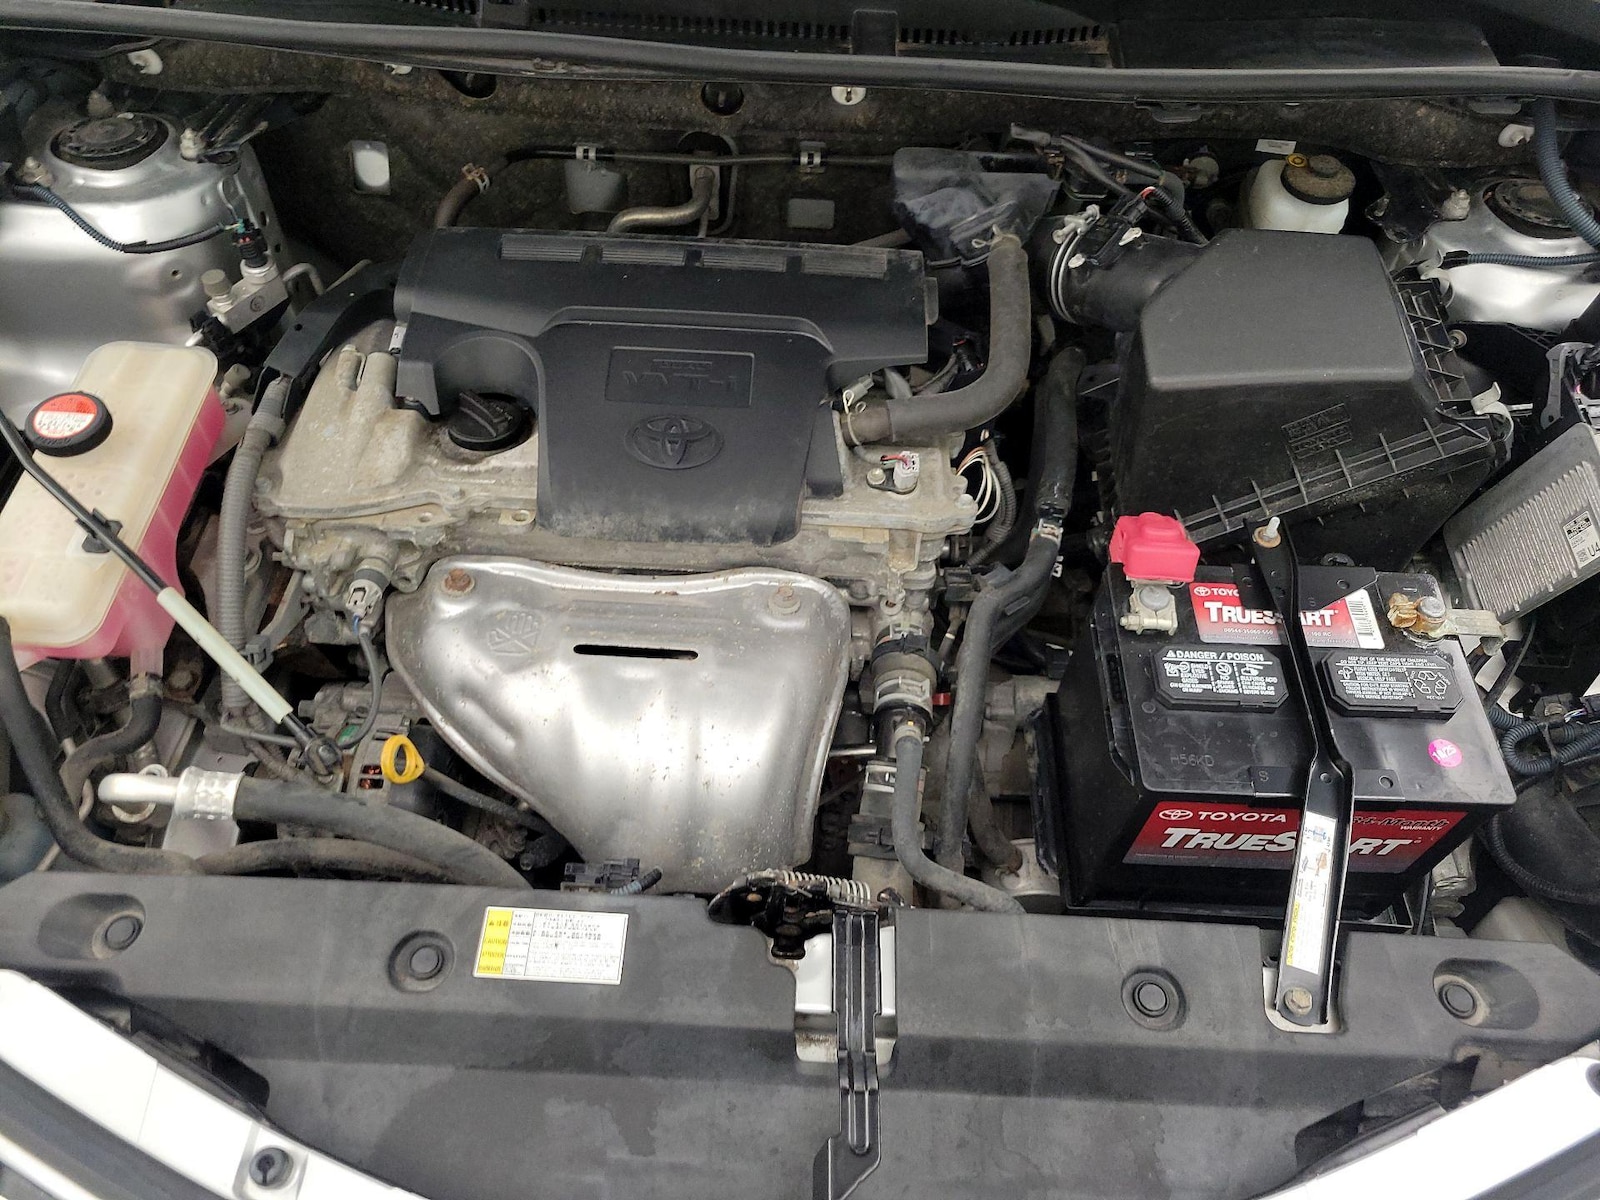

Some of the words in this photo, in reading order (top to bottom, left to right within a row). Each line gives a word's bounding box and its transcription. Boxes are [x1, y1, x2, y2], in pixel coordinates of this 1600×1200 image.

[1176, 650, 1218, 660] DANGER
[1227, 652, 1265, 661] POISON
[1198, 811, 1287, 823] TOYOTA
